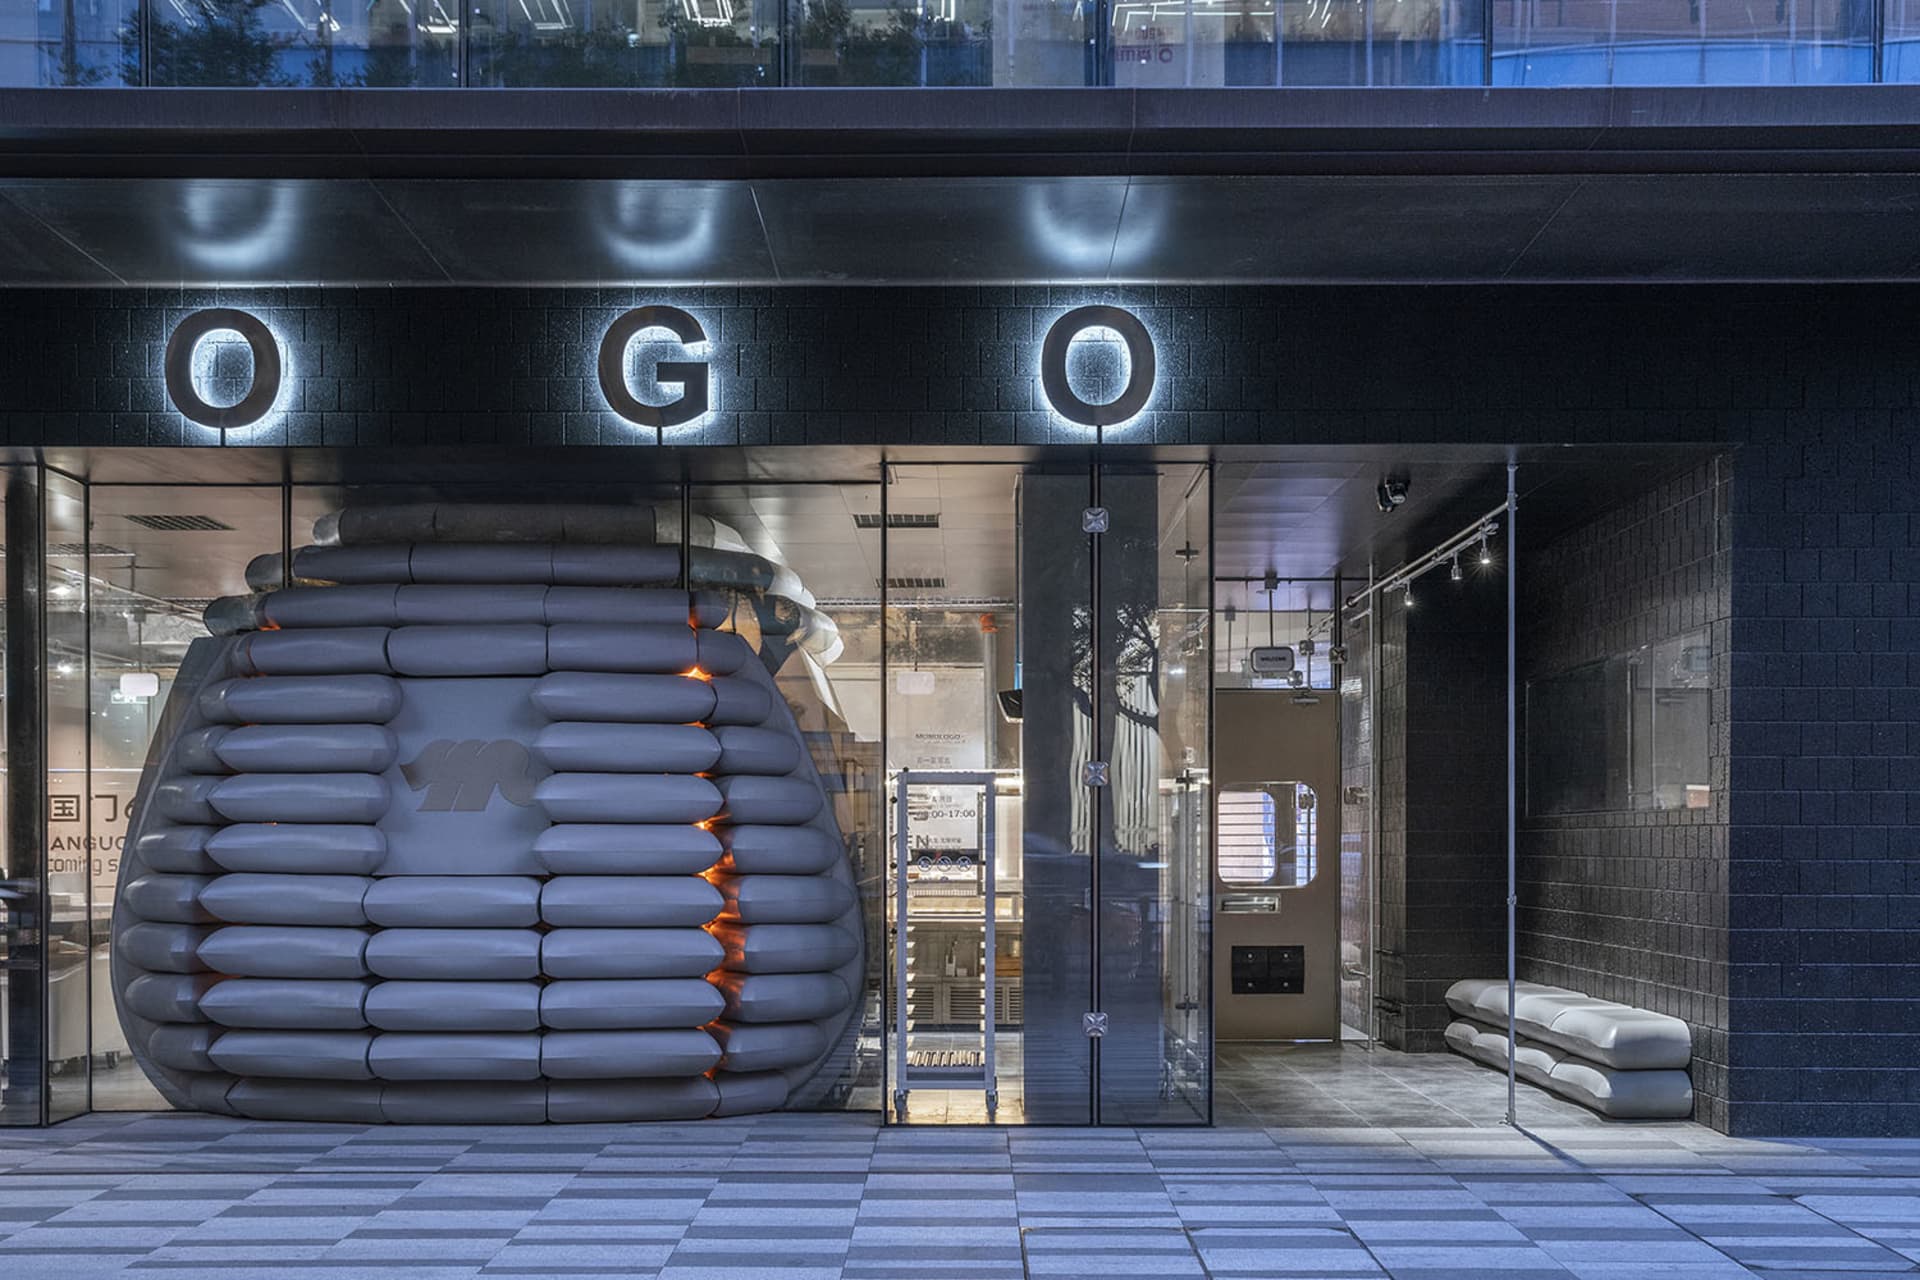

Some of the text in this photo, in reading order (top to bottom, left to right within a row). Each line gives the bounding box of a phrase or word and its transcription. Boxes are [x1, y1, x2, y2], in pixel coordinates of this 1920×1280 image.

[165, 305, 1156, 428] O G O
[48, 794, 134, 822] 国门
